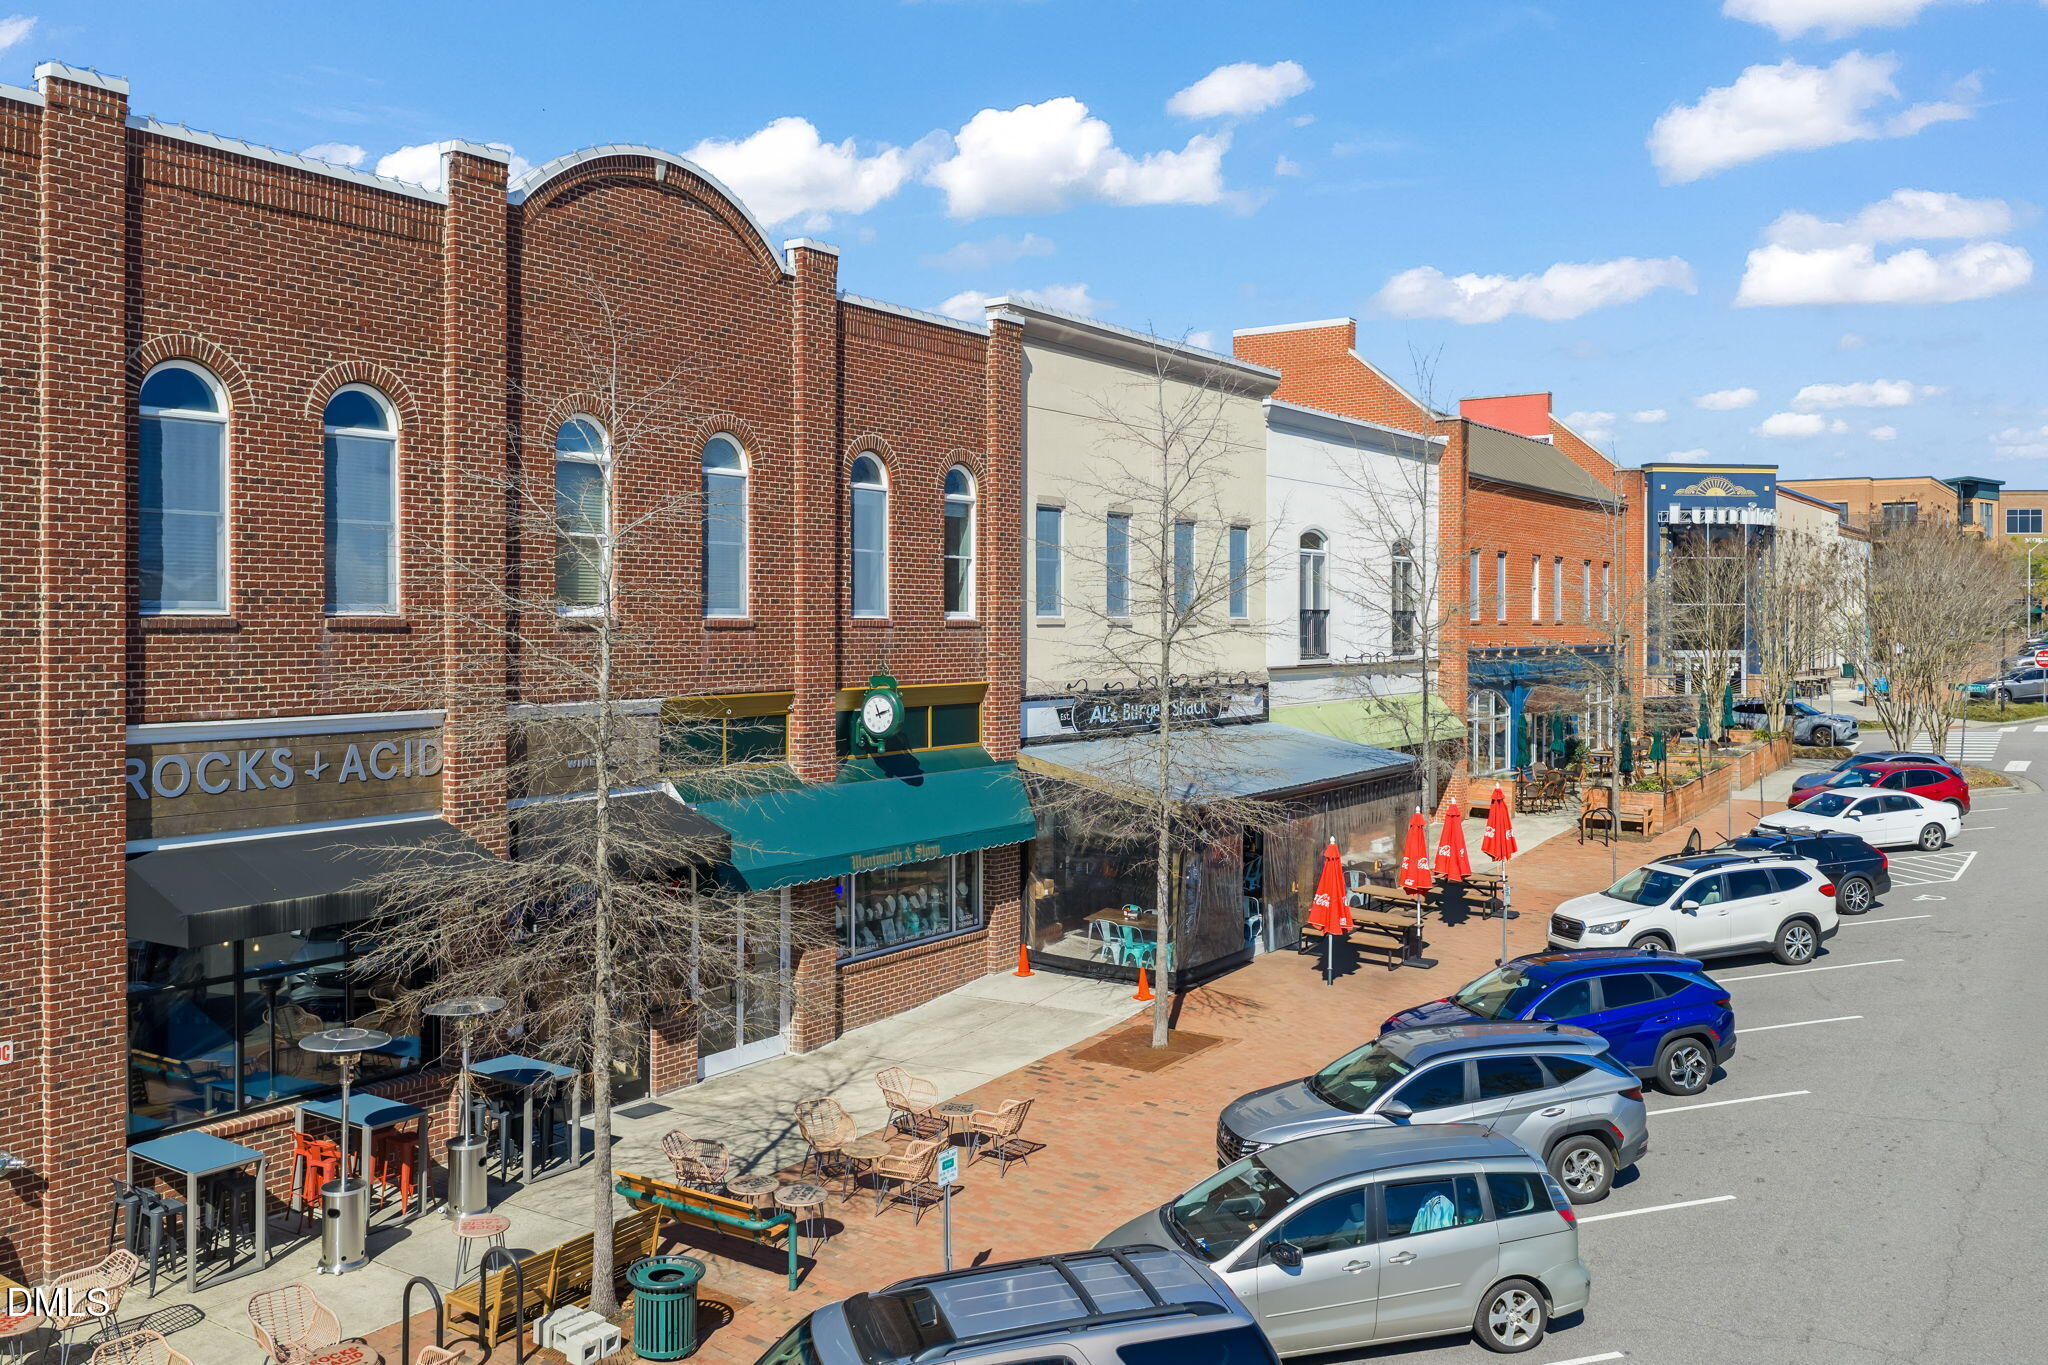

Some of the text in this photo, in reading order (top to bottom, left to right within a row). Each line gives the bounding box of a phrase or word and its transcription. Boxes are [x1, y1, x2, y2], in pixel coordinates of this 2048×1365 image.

[1122, 702, 1163, 723] Burge
[126, 748, 294, 800] ROCKS
[338, 738, 443, 783] ACID
[905, 847, 912, 860] &
